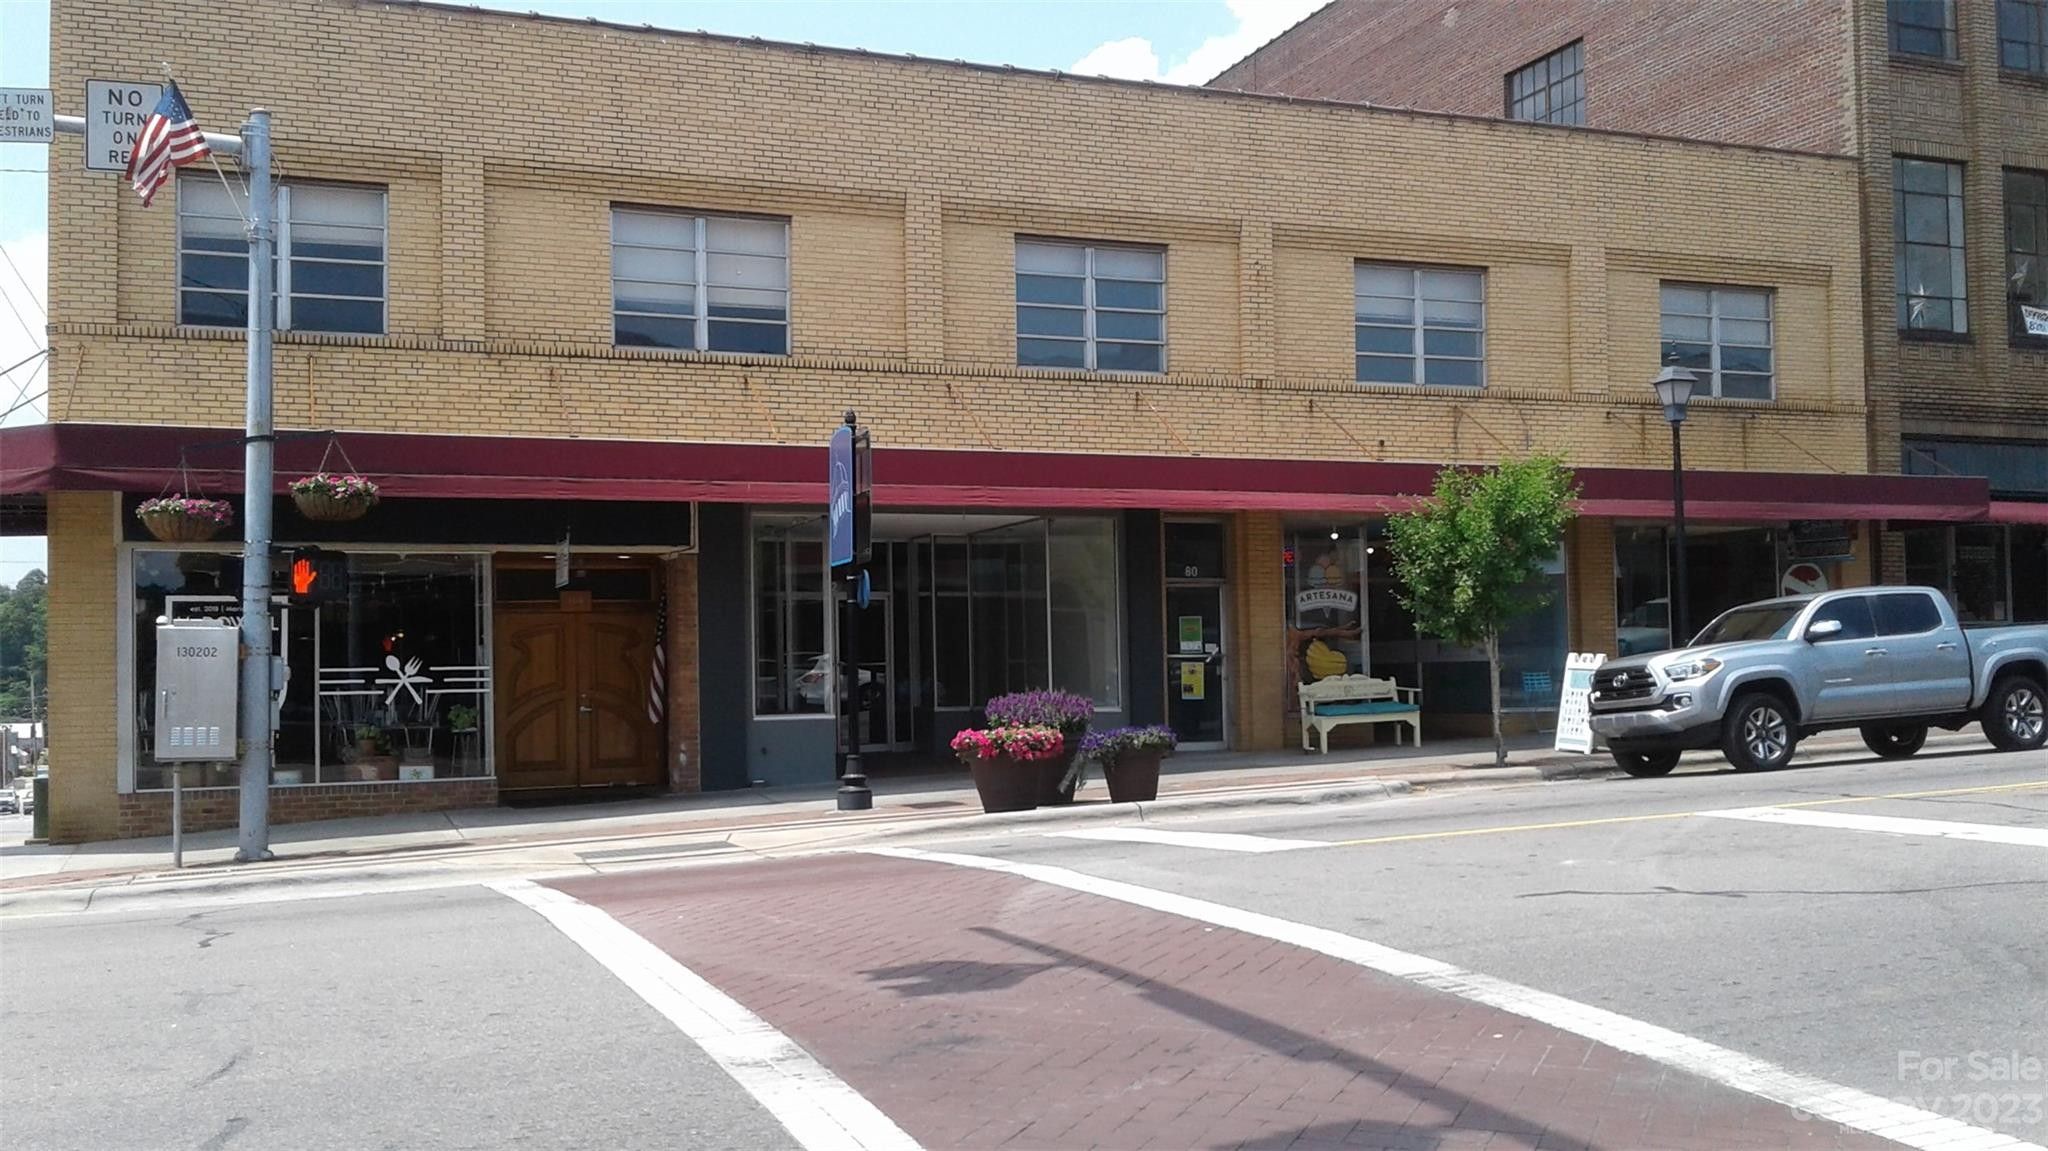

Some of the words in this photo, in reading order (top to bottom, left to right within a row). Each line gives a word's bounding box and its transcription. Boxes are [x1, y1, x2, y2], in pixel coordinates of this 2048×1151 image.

[16, 94, 44, 105] TURN
[109, 89, 142, 106] NO
[27, 110, 40, 121] TO
[102, 110, 147, 126] TURN
[113, 131, 137, 144] ON
[109, 150, 131, 164] RE
[1300, 591, 1353, 603] ARTESANA
[177, 647, 218, 657] 130202
